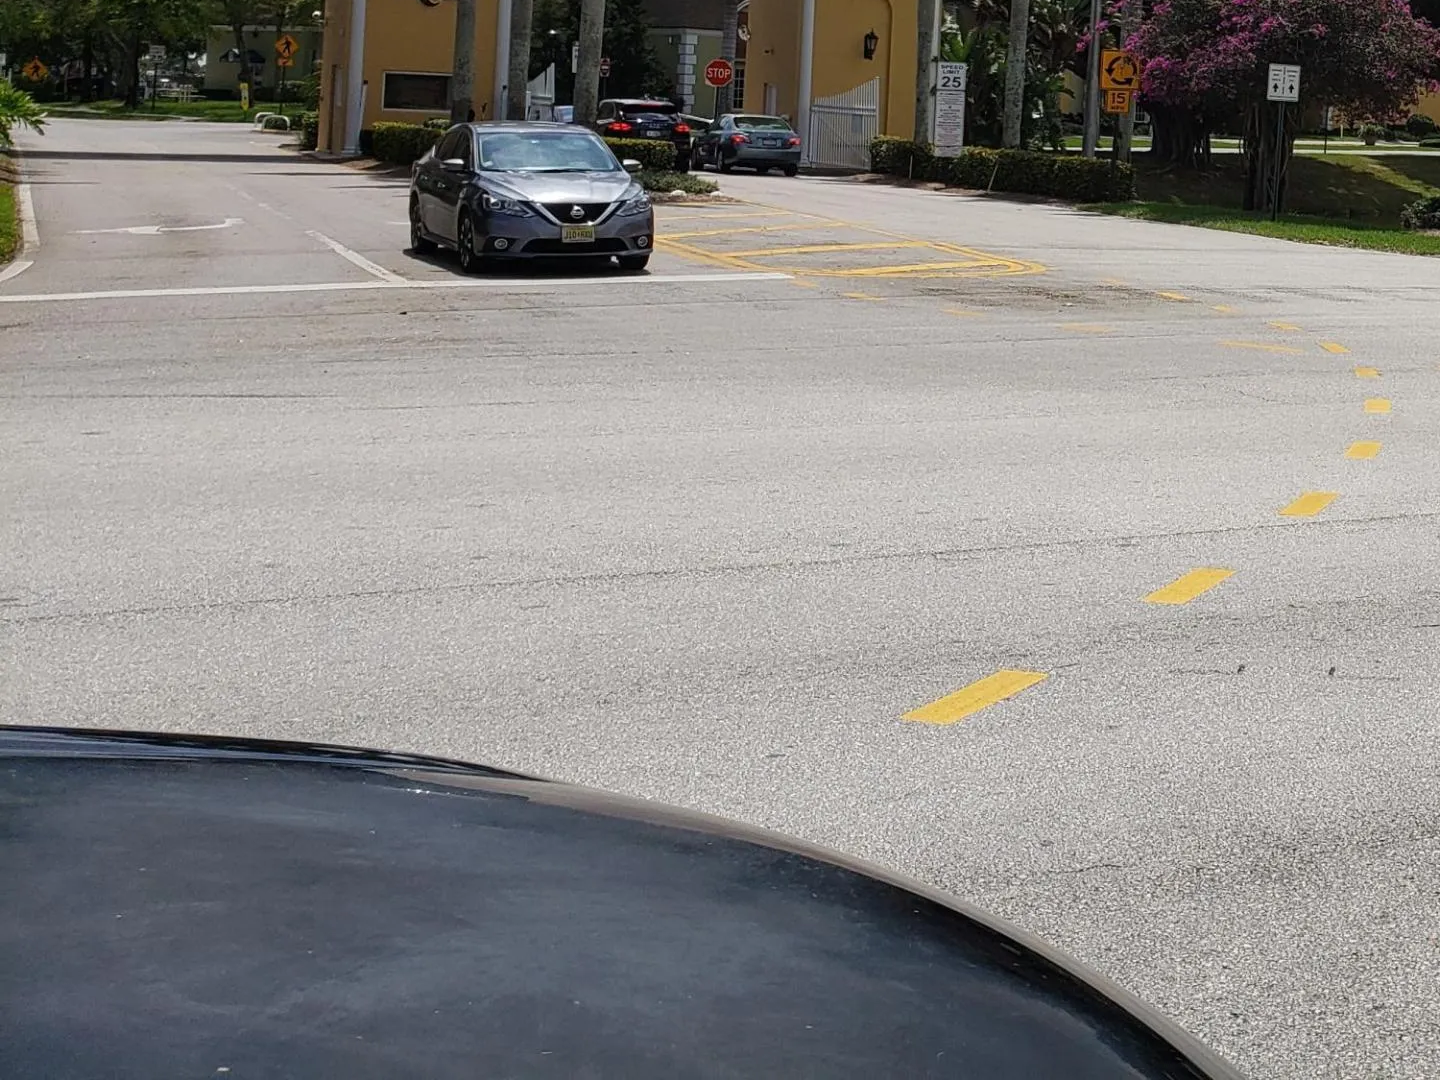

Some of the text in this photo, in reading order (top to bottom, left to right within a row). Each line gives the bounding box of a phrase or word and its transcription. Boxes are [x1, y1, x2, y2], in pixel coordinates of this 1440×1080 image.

[707, 67, 731, 79] STOP
[941, 76, 962, 88] 25
[1111, 92, 1126, 104] 15
